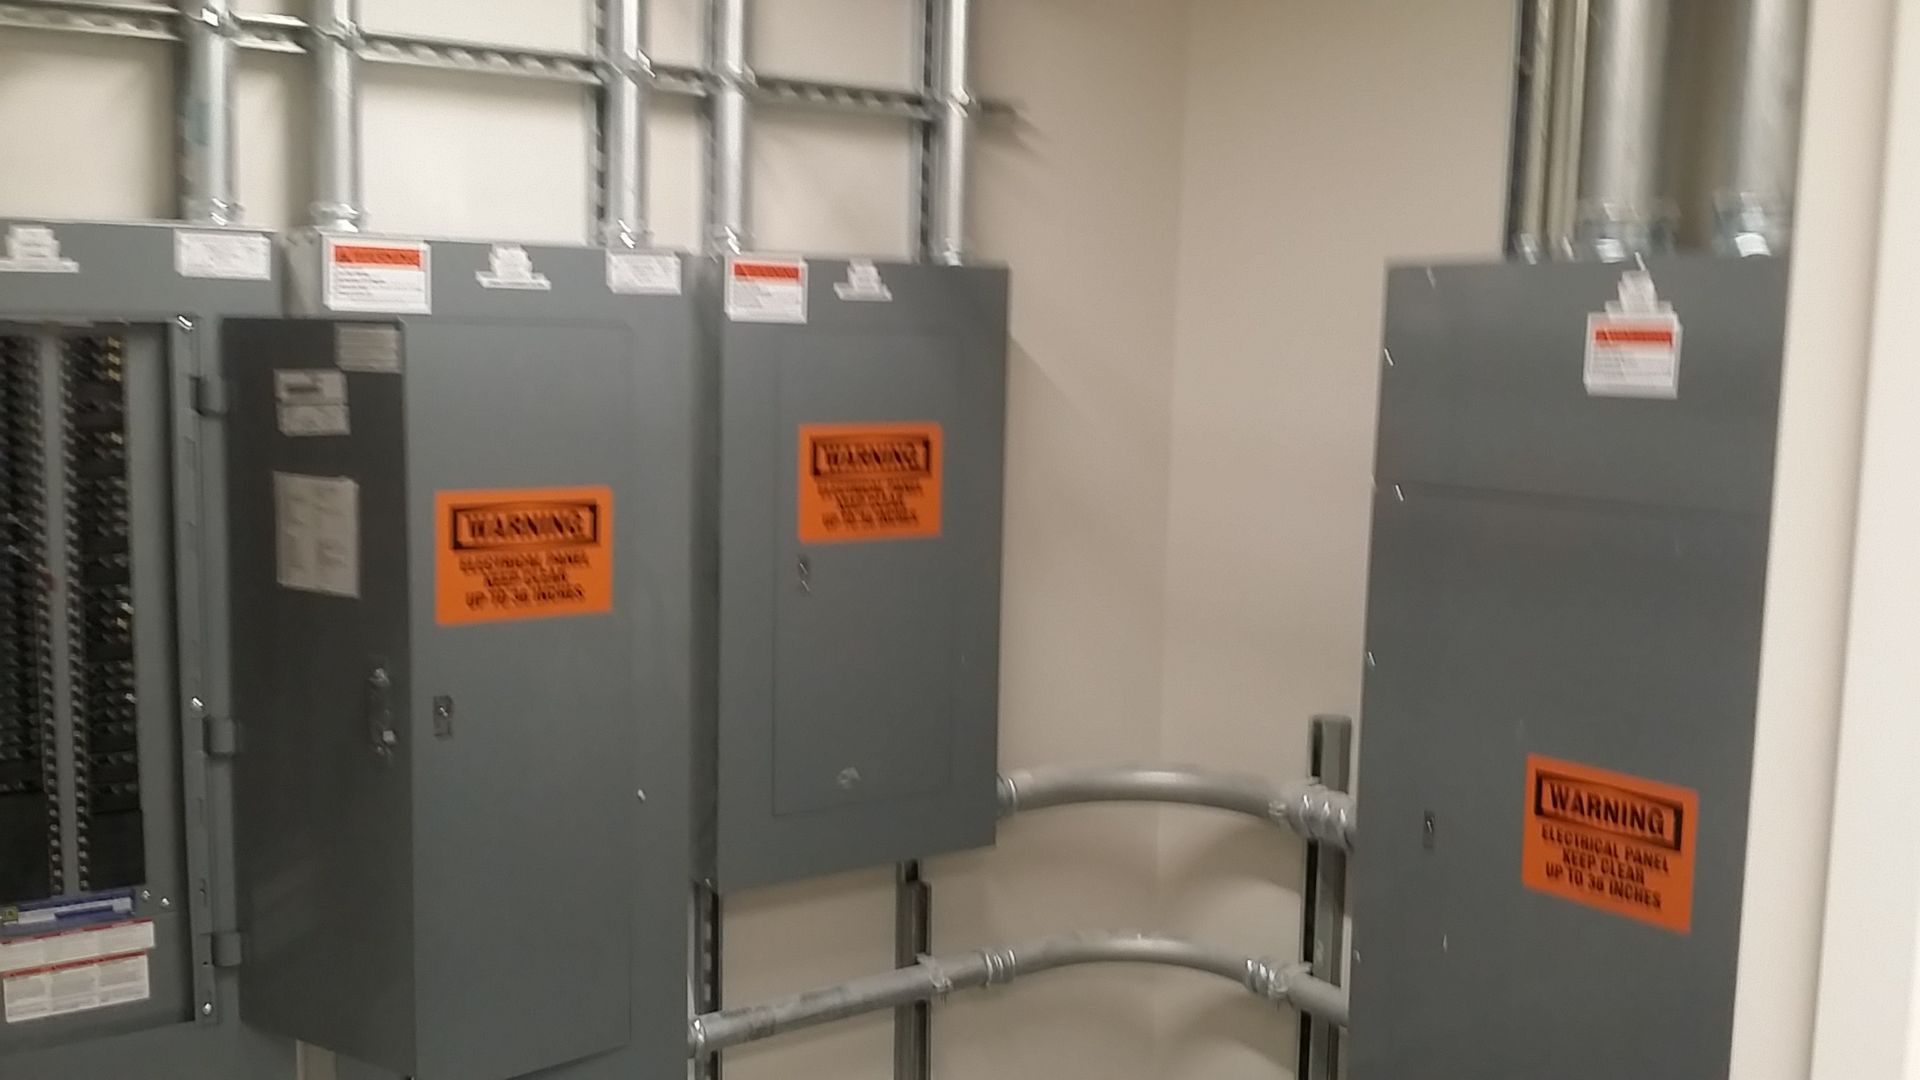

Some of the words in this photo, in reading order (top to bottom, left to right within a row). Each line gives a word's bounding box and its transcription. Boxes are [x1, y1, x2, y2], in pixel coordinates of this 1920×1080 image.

[463, 512, 584, 539] WARNING
[1549, 783, 1665, 837] WARNING
[1541, 822, 1619, 859] ELECTRICAL
[1623, 846, 1670, 874] PANEL
[1562, 849, 1597, 869] KEEP
[1600, 855, 1646, 886] CLEAR
[1545, 862, 1563, 879] UP
[1567, 867, 1584, 888] TO
[1608, 880, 1662, 910] INCHES
